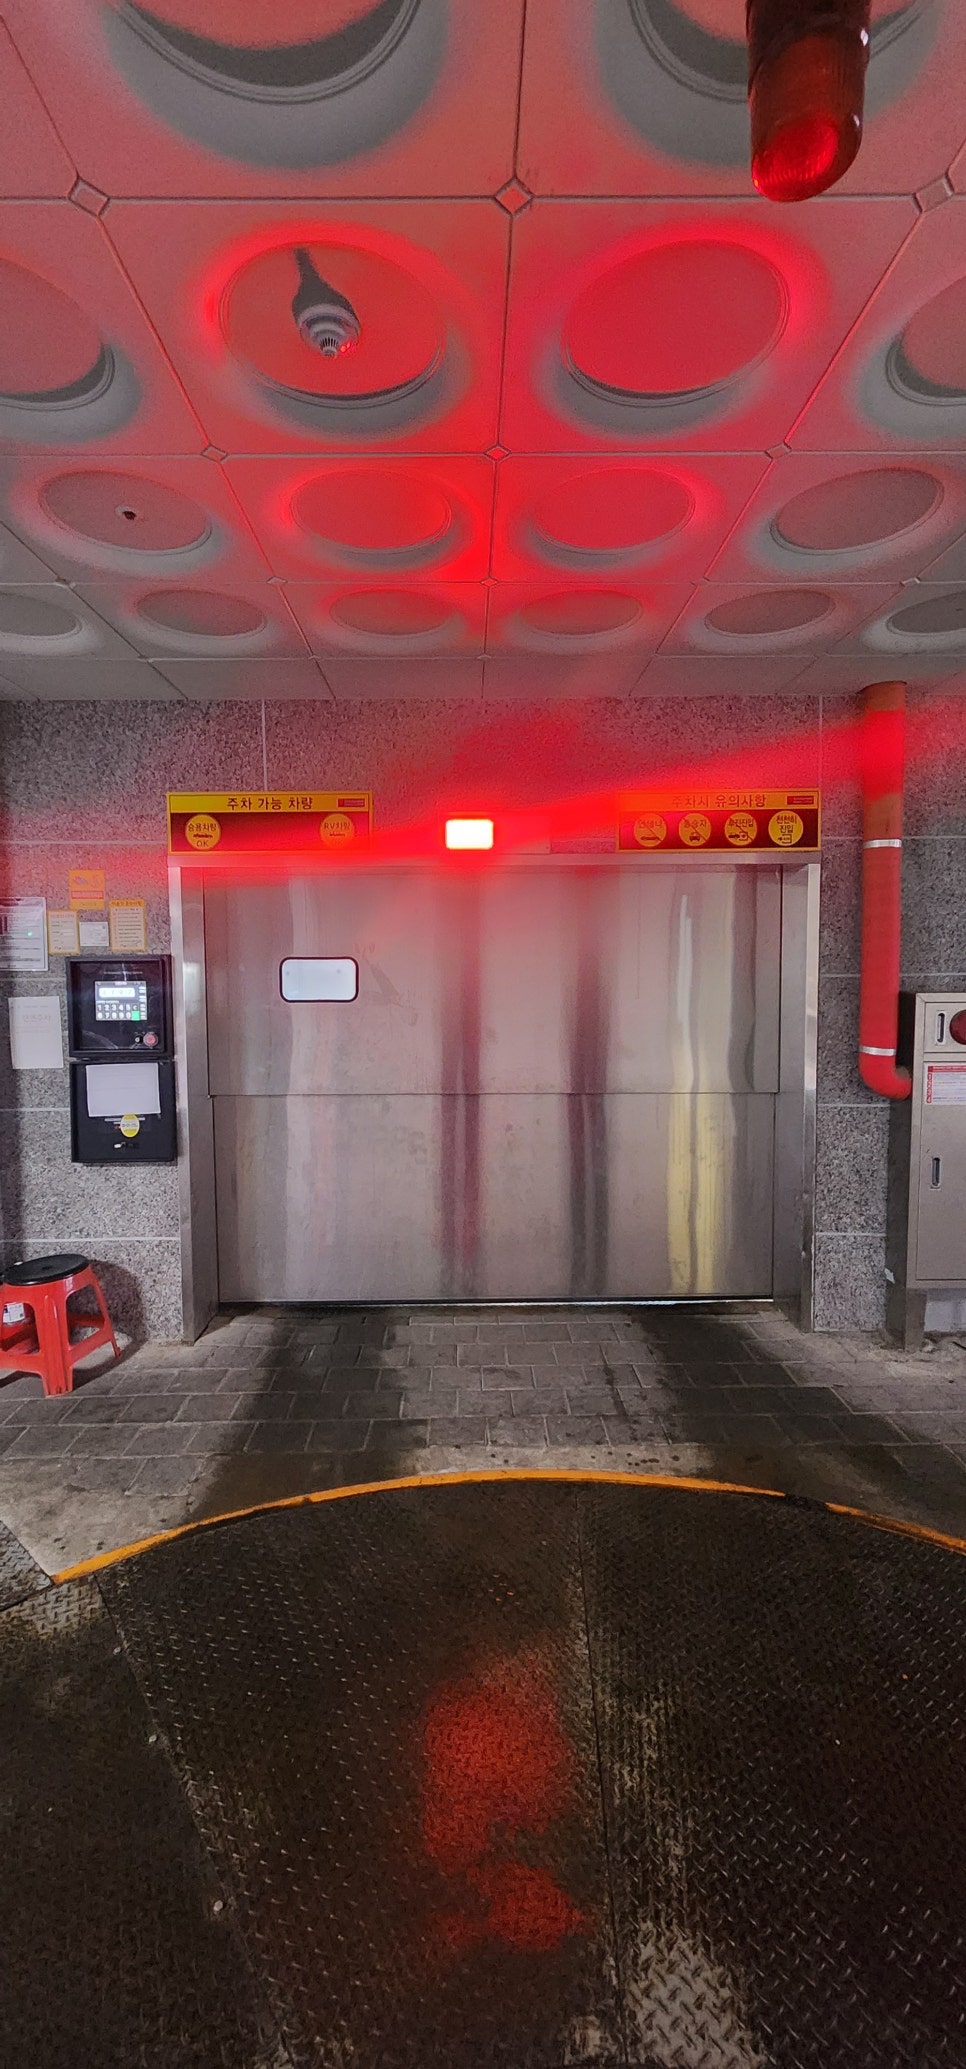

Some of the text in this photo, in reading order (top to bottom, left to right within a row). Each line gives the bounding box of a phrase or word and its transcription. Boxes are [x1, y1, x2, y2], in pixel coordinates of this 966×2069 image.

[227, 796, 313, 811] 주차 가능 차량
[672, 794, 766, 808] 주차시 유의사항
[779, 824, 794, 834] 진입
[196, 840, 209, 848] OK
